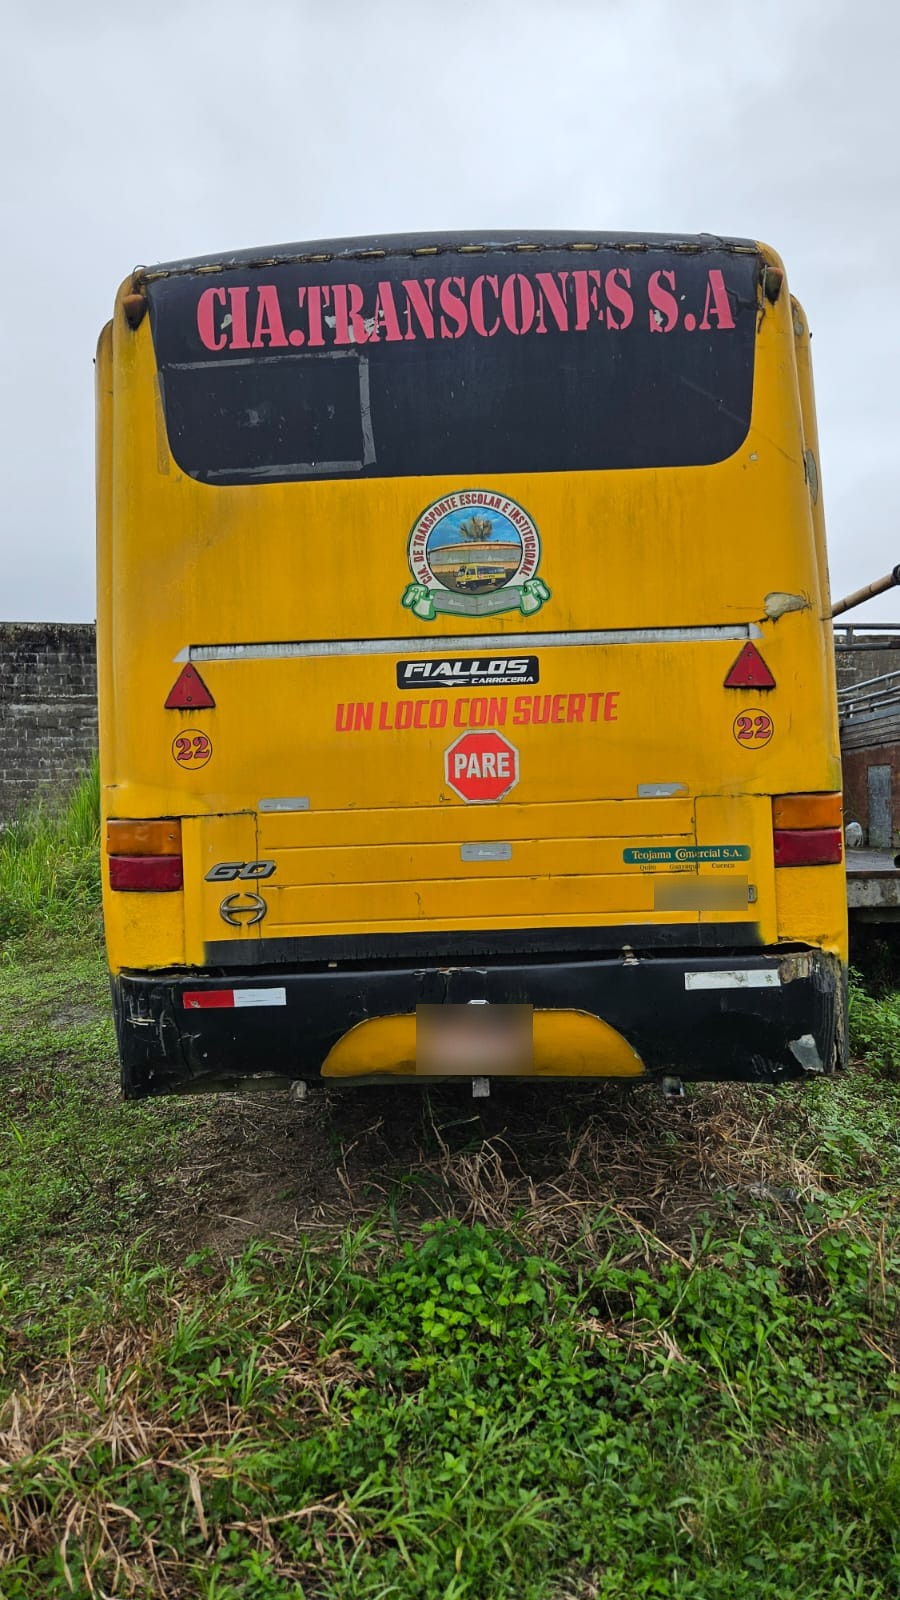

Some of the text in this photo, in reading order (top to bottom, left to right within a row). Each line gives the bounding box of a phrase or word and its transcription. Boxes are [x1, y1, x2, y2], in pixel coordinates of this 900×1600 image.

[459, 493, 503, 509] ESCOLAR
[501, 502, 511, 512] E
[413, 496, 458, 547] TRANSPORTE
[508, 507, 536, 577] INSTITUCIONAL
[413, 550, 424, 563] DE
[403, 659, 530, 678] FIALLOS
[471, 676, 534, 684] CARROCERIA
[335, 691, 621, 732] UN LOCO CON SUERTE
[737, 715, 771, 740] 22
[175, 736, 210, 761] 22
[454, 752, 511, 779] PARE
[722, 848, 743, 857] S.A.
